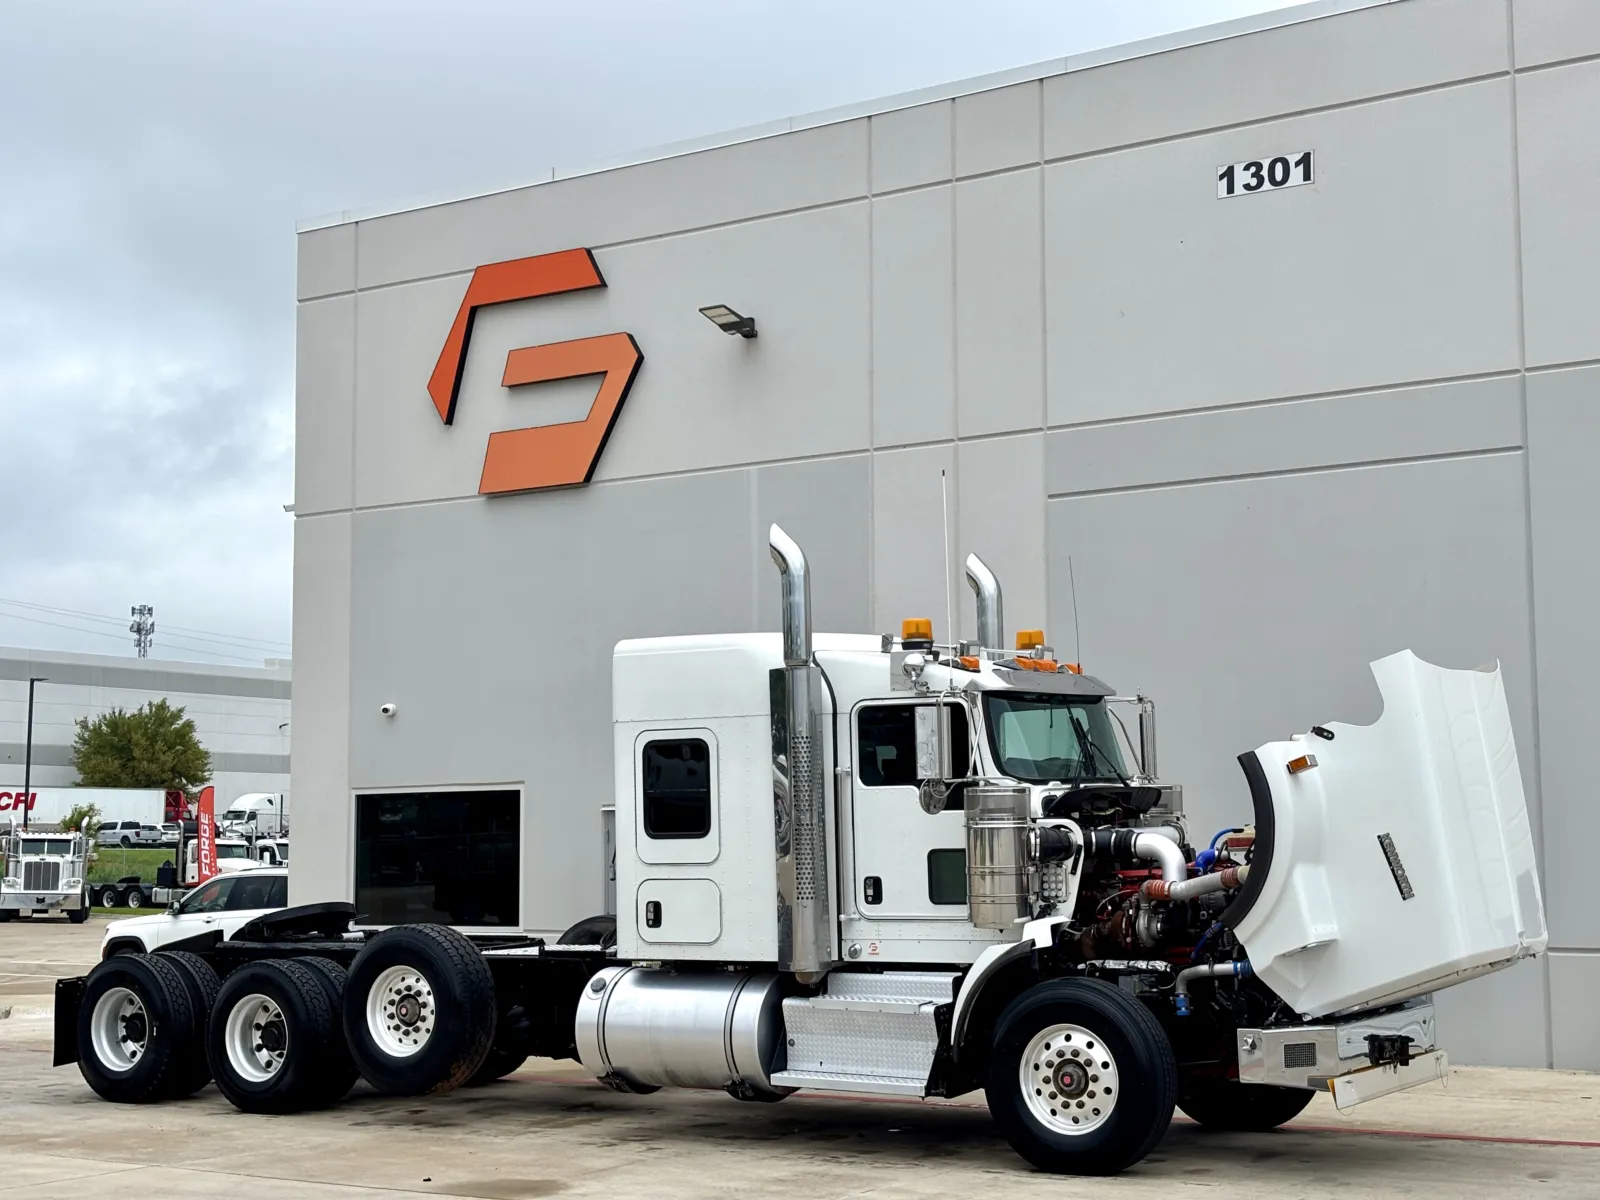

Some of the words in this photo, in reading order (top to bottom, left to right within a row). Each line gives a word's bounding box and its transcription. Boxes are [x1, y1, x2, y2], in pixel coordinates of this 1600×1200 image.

[1218, 151, 1312, 195] 1301
[0, 792, 37, 811] CFI
[201, 812, 211, 875] FORGE
[1379, 832, 1415, 899] KENWORTH
